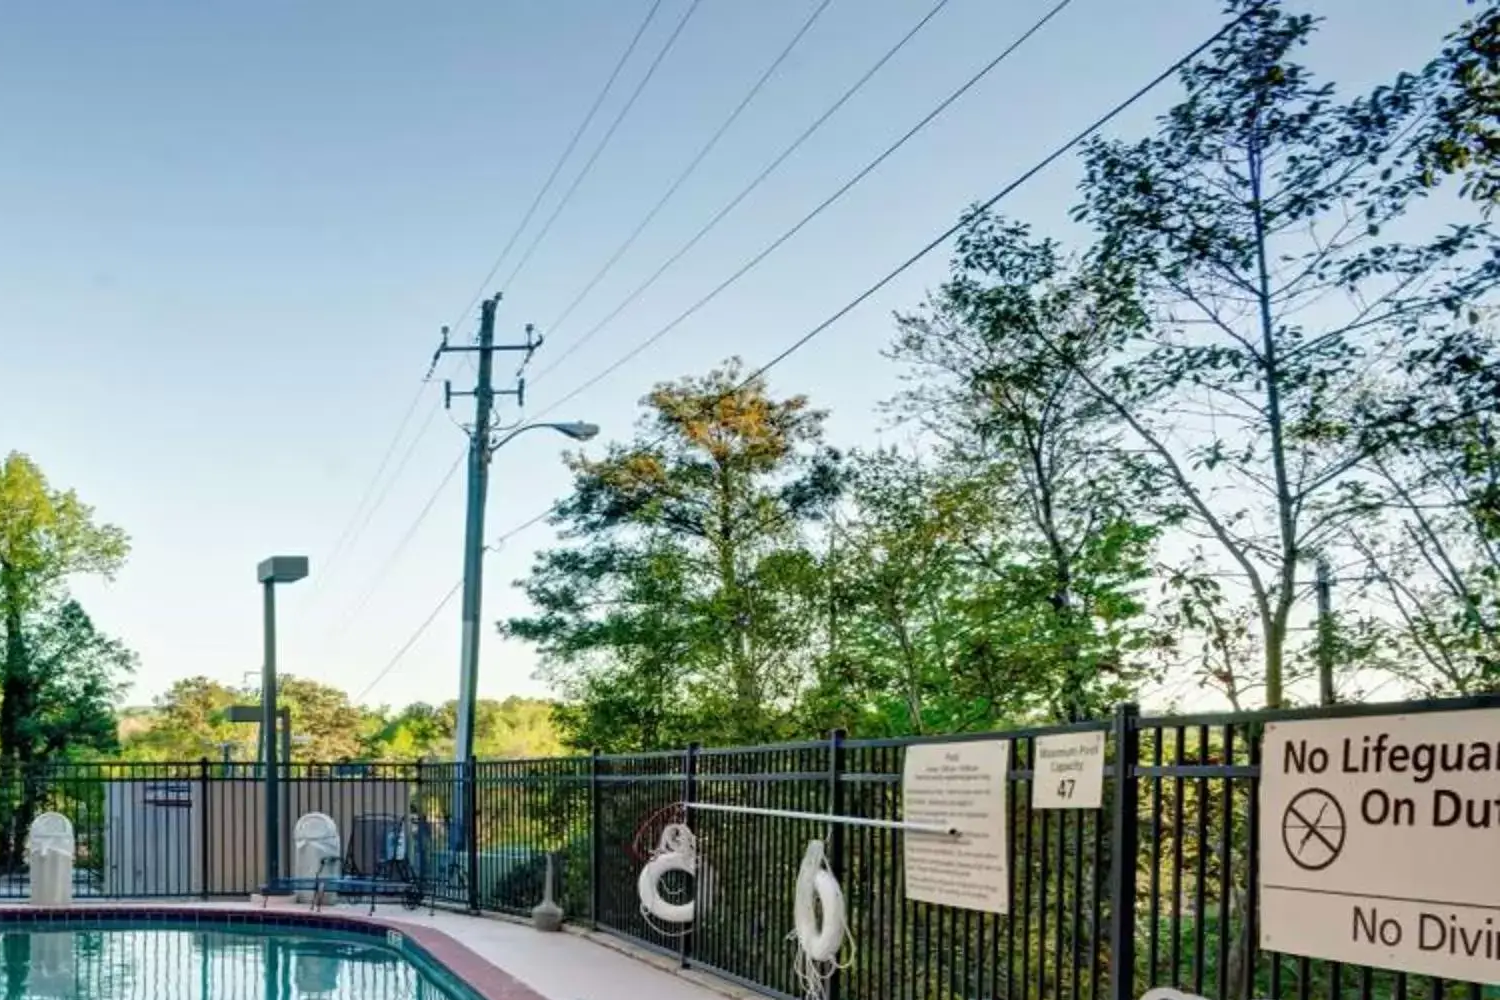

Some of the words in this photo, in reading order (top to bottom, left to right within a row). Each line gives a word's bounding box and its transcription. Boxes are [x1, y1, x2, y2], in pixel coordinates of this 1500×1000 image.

[1284, 739, 1329, 774] No
[1342, 733, 1500, 783] Lifegua
[1057, 779, 1077, 799] 47
[1361, 788, 1415, 826] On
[1353, 905, 1402, 947] No
